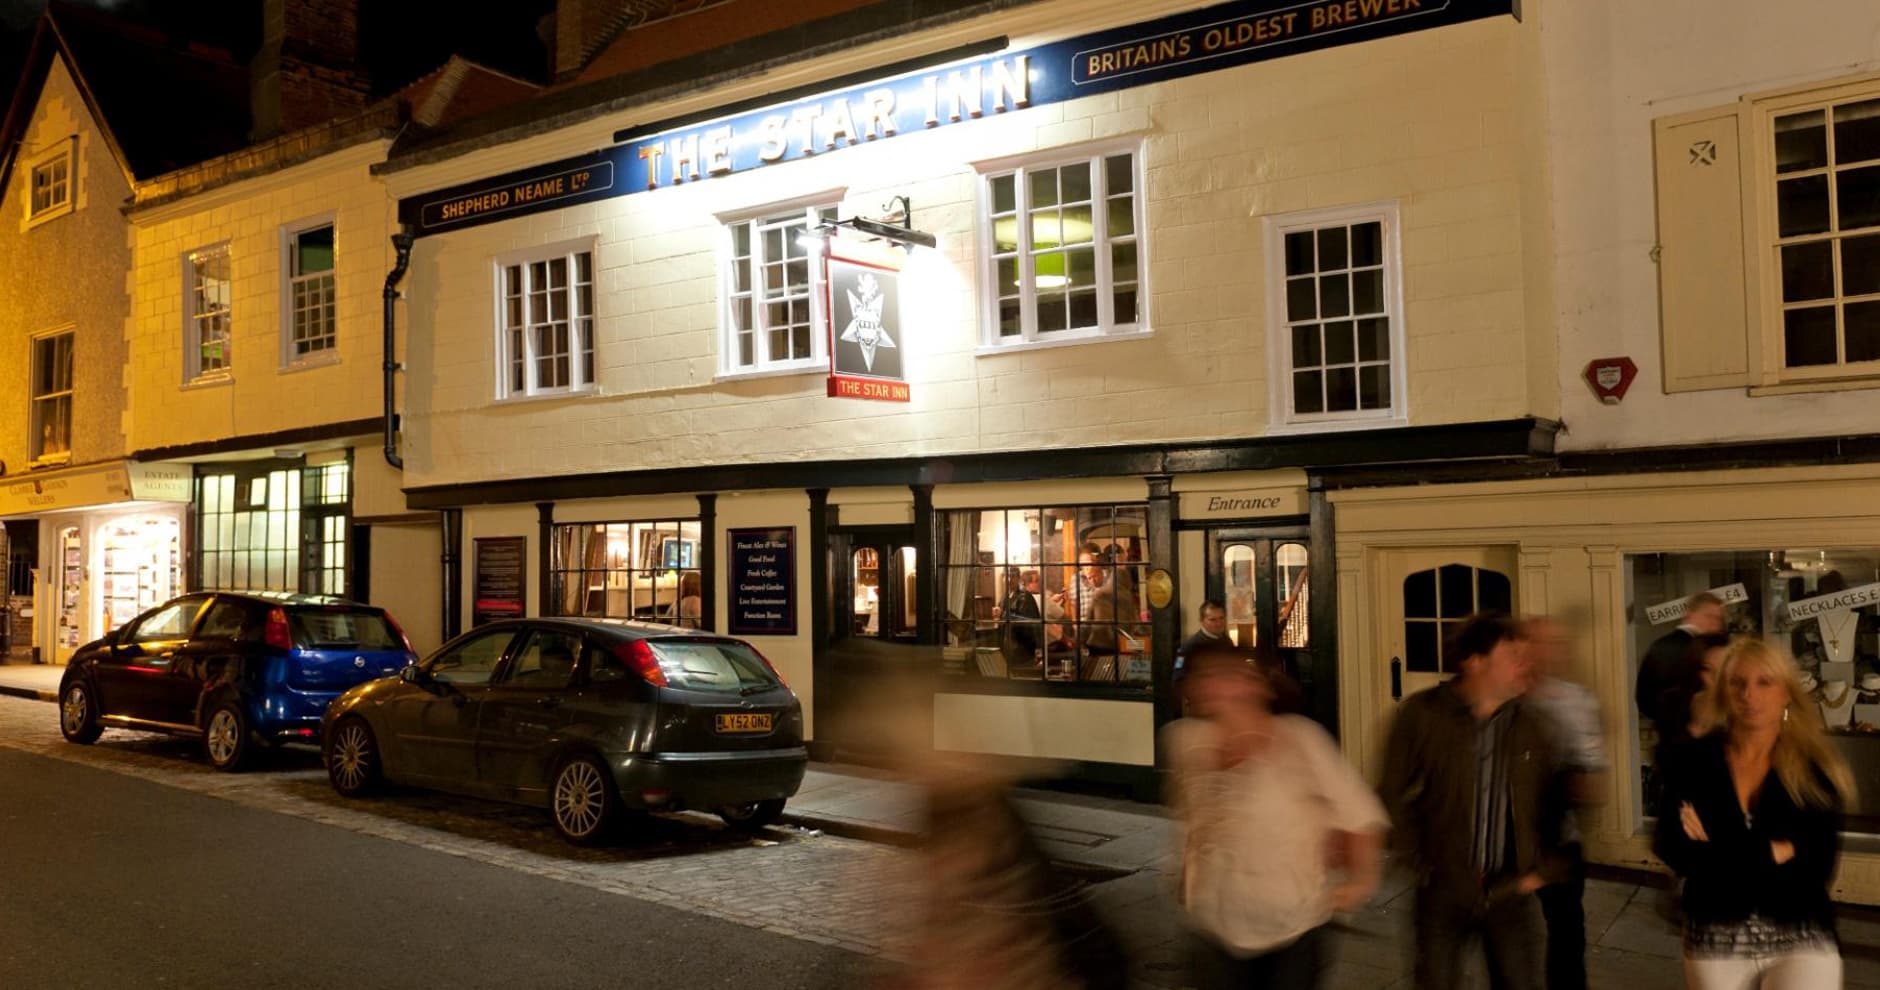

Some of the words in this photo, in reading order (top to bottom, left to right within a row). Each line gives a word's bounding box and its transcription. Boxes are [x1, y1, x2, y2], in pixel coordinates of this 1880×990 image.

[1087, 34, 1191, 76] BRITAIN'S
[1203, 12, 1299, 51] OLDEST
[637, 124, 733, 190] THE
[758, 86, 898, 164] STAR
[923, 54, 1033, 128] INN
[441, 190, 510, 219] SHEPHERD
[514, 178, 564, 203] NEAME
[839, 380, 861, 395] THE
[863, 383, 889, 399] STAR
[891, 385, 908, 399] INN
[144, 471, 180, 480] ESTATE
[143, 482, 184, 490] AGENTS
[1207, 496, 1281, 512] Entrance
[748, 555, 762, 563] Good
[763, 555, 776, 563] Food
[1650, 602, 1688, 621] EARRIN
[1791, 591, 1867, 618] NECKLACES
[723, 715, 749, 728] LY52
